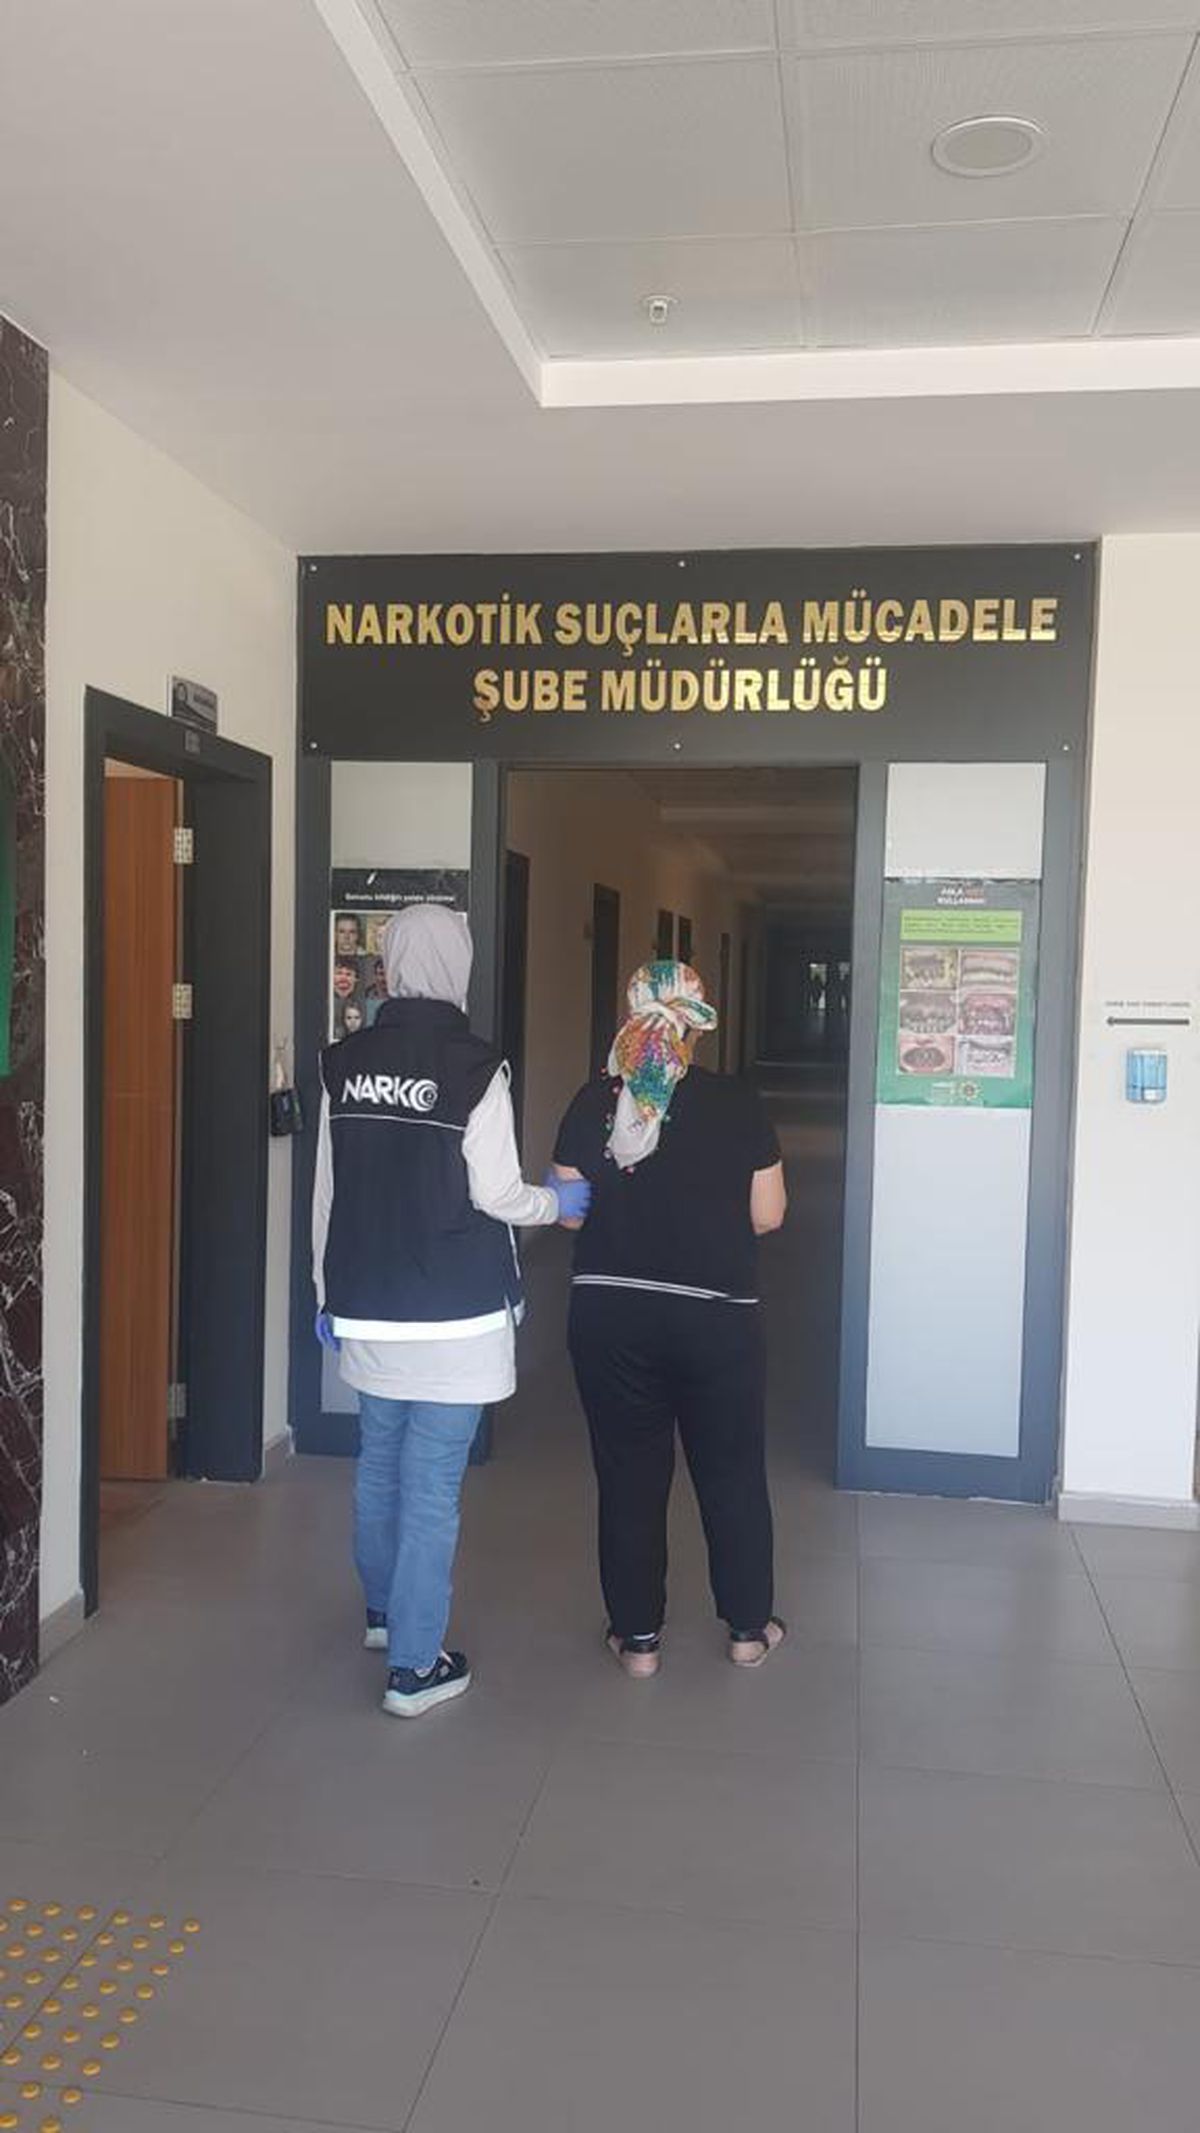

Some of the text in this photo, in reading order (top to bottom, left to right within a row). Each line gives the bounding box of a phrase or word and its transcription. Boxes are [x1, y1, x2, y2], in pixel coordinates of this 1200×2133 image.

[326, 589, 1058, 655] NARKOTİK SUÇLARLA MÜCADELE
[473, 656, 888, 721] ŞUBE MÜDÜRLÜĞÜ
[342, 1073, 438, 1112] NARKO
